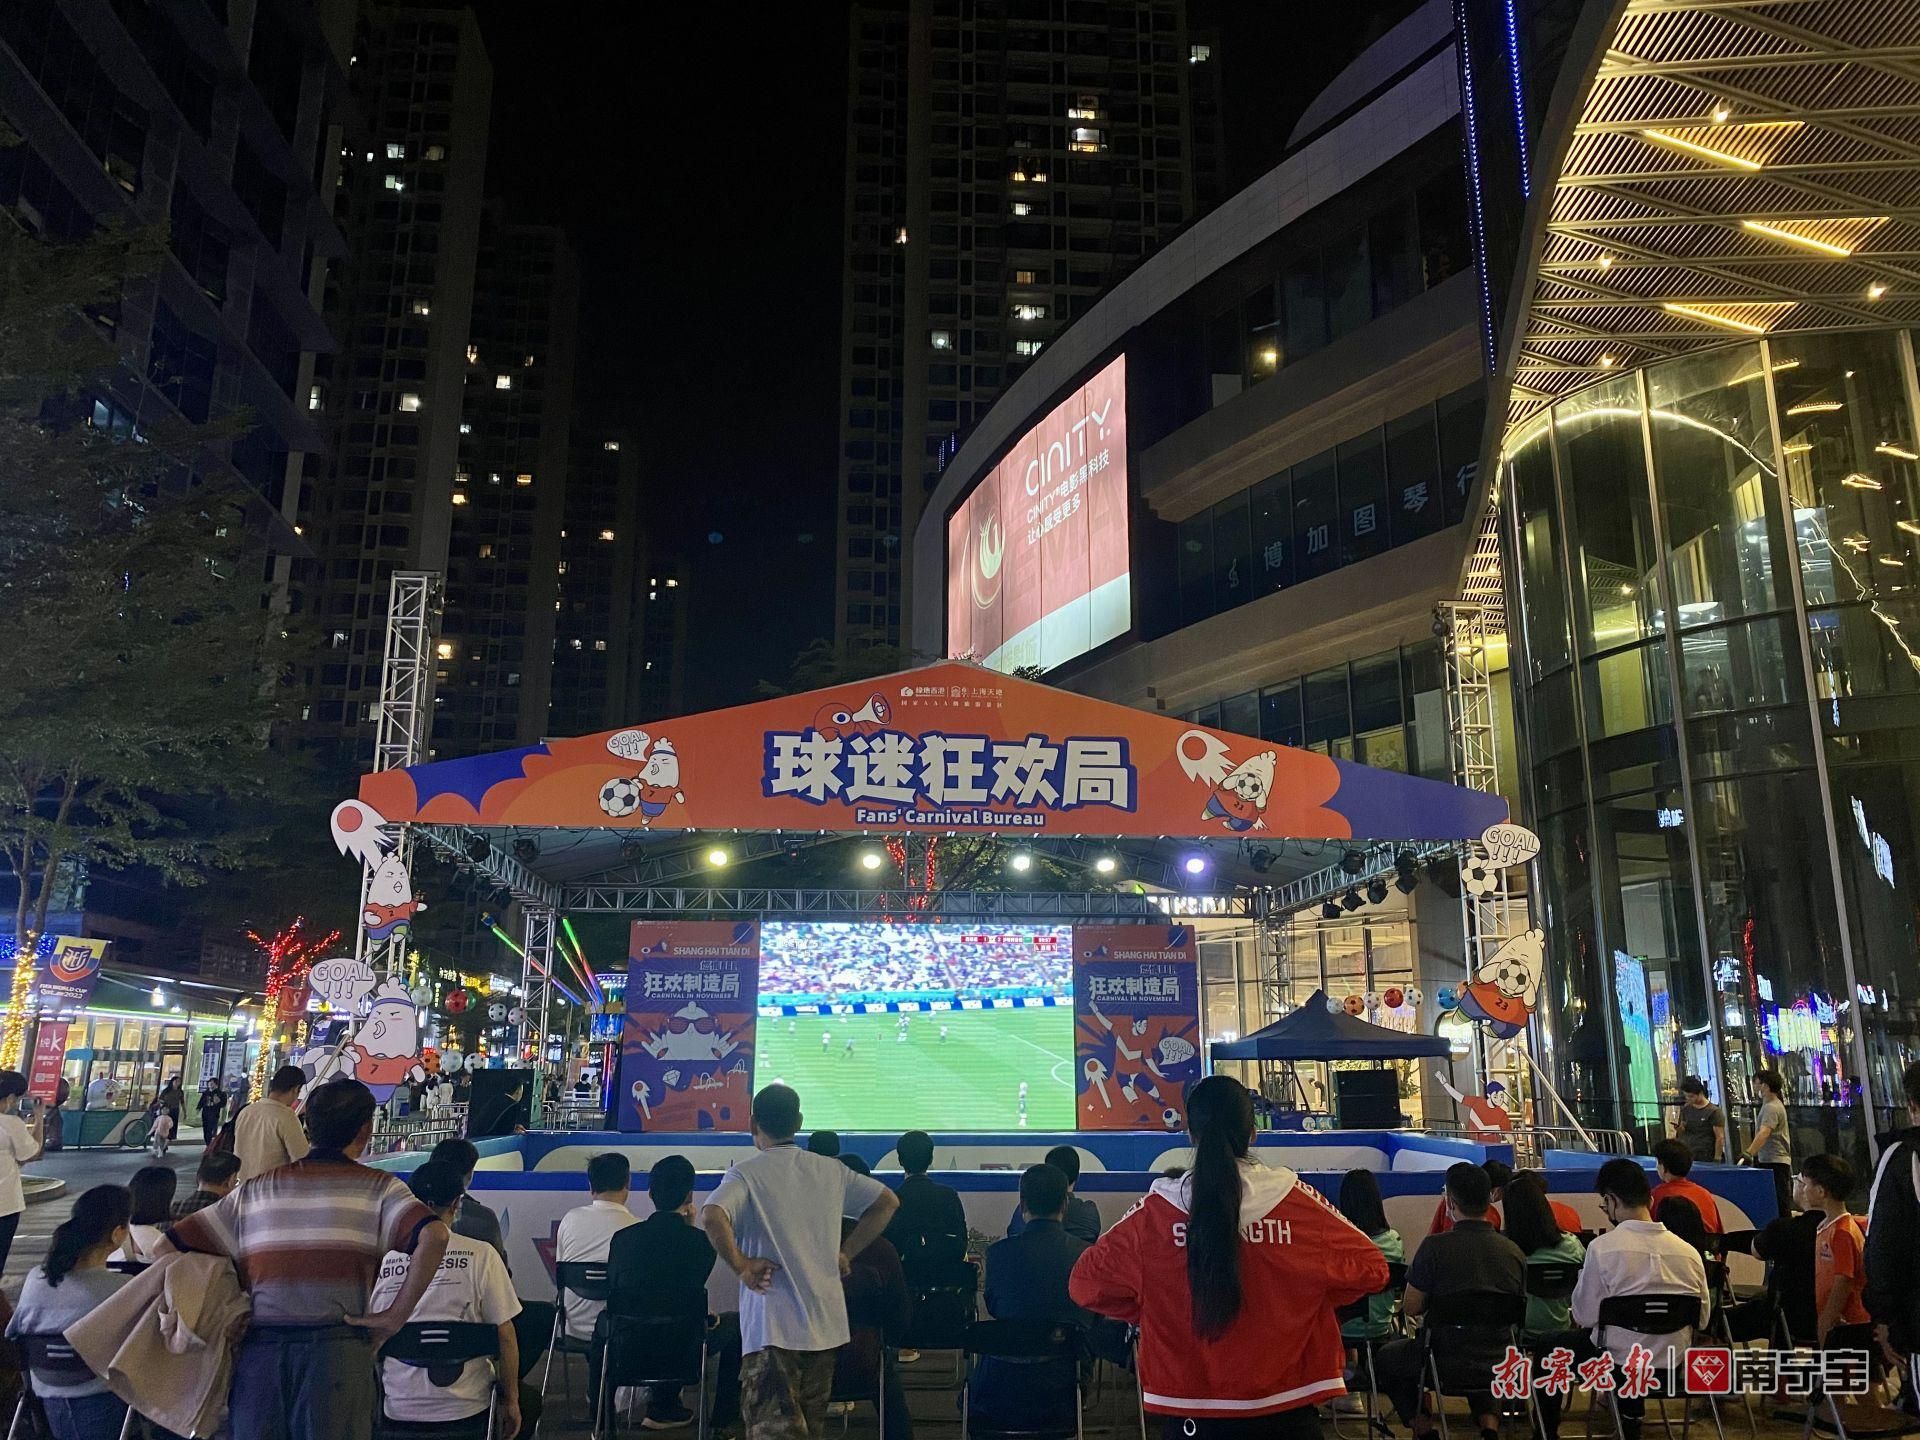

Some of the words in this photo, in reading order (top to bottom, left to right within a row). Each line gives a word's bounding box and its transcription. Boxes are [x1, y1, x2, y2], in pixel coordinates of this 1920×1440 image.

[1027, 493, 1081, 545] 让心感受更多
[608, 731, 648, 748] GOAL
[771, 731, 1130, 810] 球迷狂欢局
[857, 808, 904, 824] Fans'
[905, 809, 979, 825] Carnival
[982, 810, 1044, 826] Bureau
[1486, 827, 1538, 852] GOAL
[673, 946, 704, 956] SHANG
[704, 947, 721, 956] HAI
[721, 947, 740, 956] TIAN
[741, 947, 751, 956] DI
[1113, 951, 1142, 959] SHANG
[1143, 951, 1157, 960] HAI
[1158, 951, 1177, 960] TIAN
[1178, 952, 1187, 960] DI
[313, 962, 374, 981] GOAL
[643, 972, 740, 998] 狂欢制造局
[1088, 975, 1180, 1001] 狂欢制造局
[1494, 997, 1509, 1012] 23
[369, 1063, 379, 1075] 7
